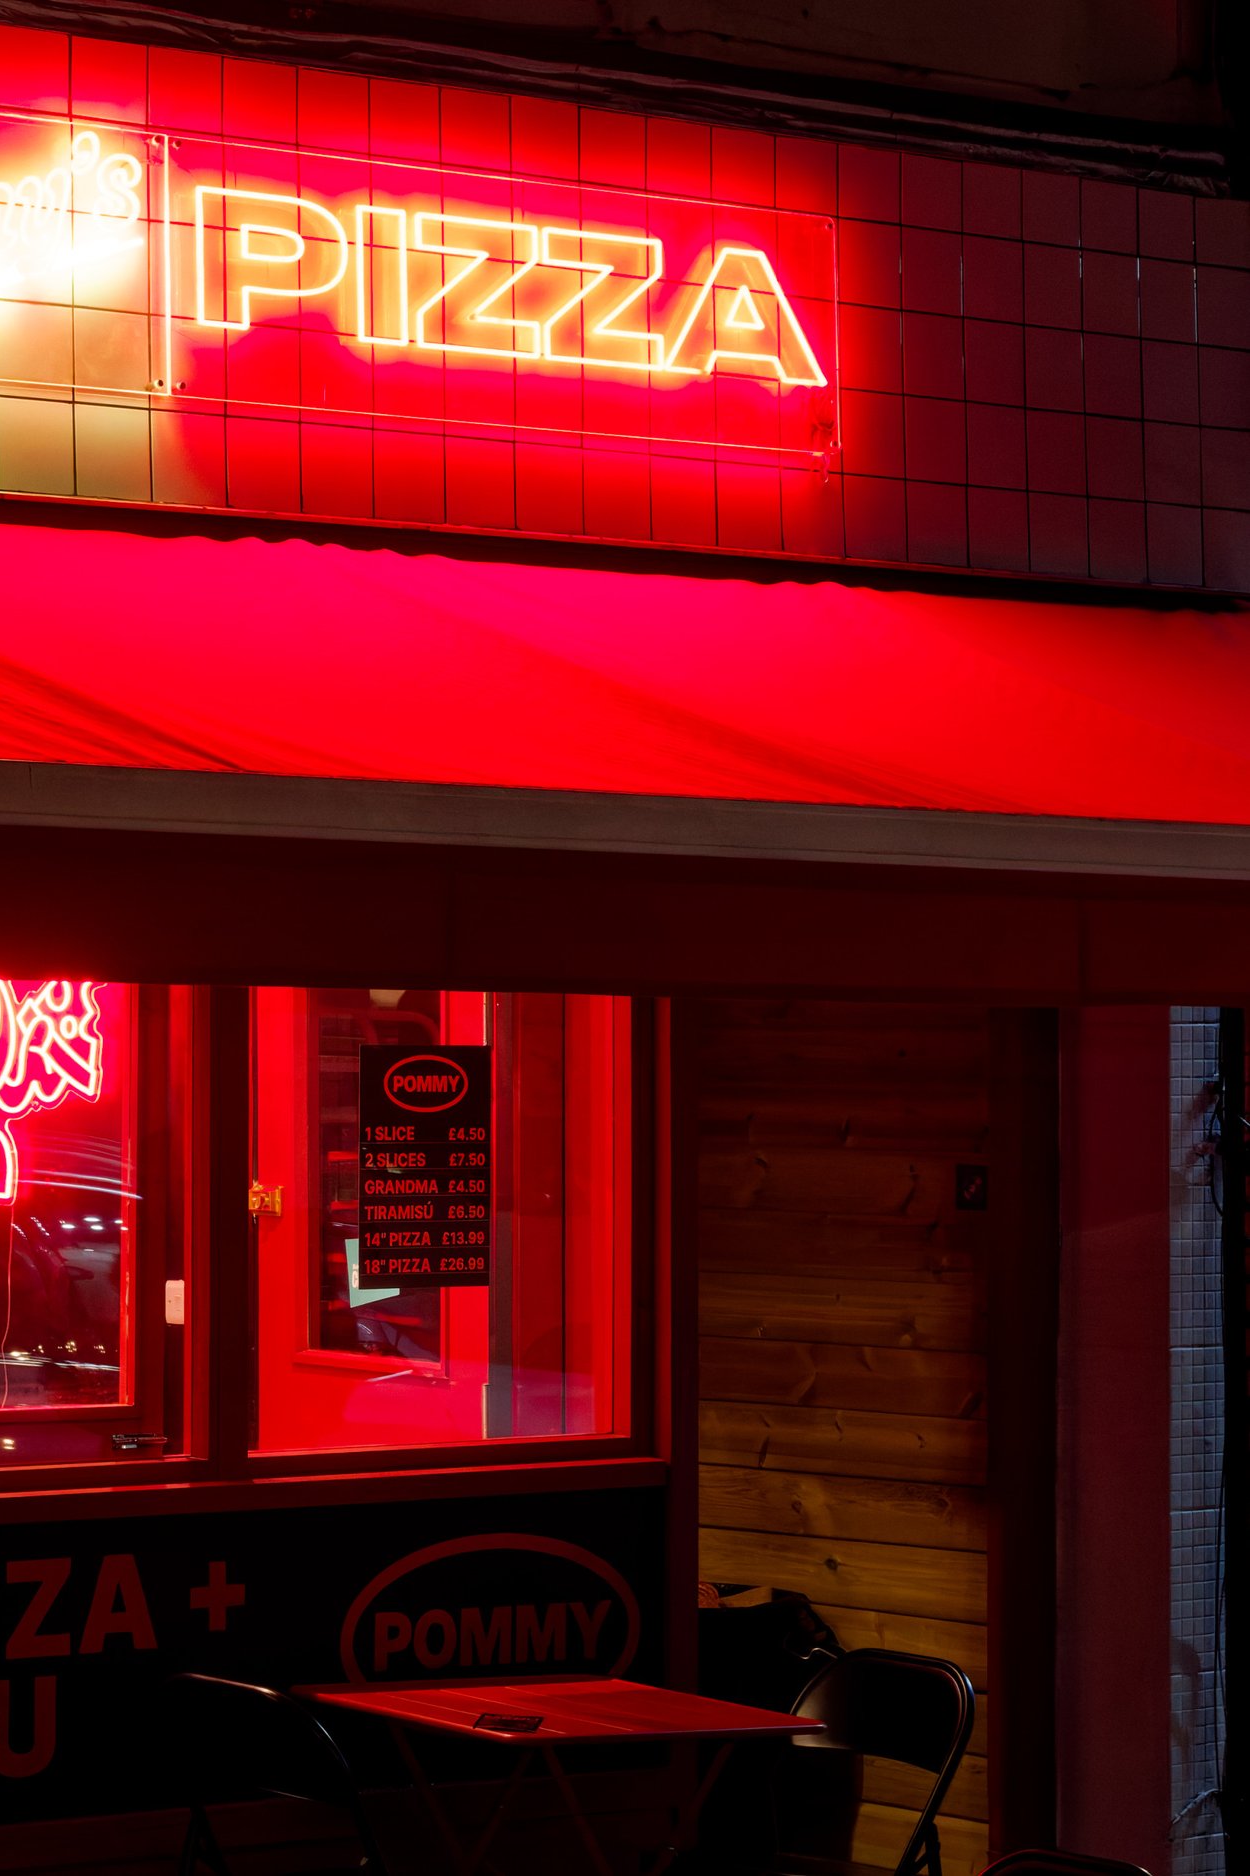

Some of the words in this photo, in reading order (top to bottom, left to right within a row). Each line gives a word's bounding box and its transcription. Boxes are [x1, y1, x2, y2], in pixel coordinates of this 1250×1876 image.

[193, 183, 828, 388] PIZZA
[393, 1075, 461, 1093] POMMY
[365, 1127, 372, 1141] 1
[375, 1126, 415, 1141] SLICE
[448, 1127, 486, 1141] £4.50
[365, 1153, 374, 1167] 2
[377, 1153, 426, 1167] SLICES
[449, 1152, 486, 1167] £7.50
[365, 1179, 439, 1194] GRANDMA
[448, 1179, 486, 1194] £4.50
[365, 1201, 434, 1220] TIRAMISÚ
[448, 1205, 485, 1219] £6.50
[389, 1231, 431, 1246] PIZZA
[442, 1231, 485, 1246] £13.99
[389, 1258, 431, 1273] PIZZA
[440, 1257, 485, 1272] £26.99
[373, 1600, 613, 1674] POMMY
